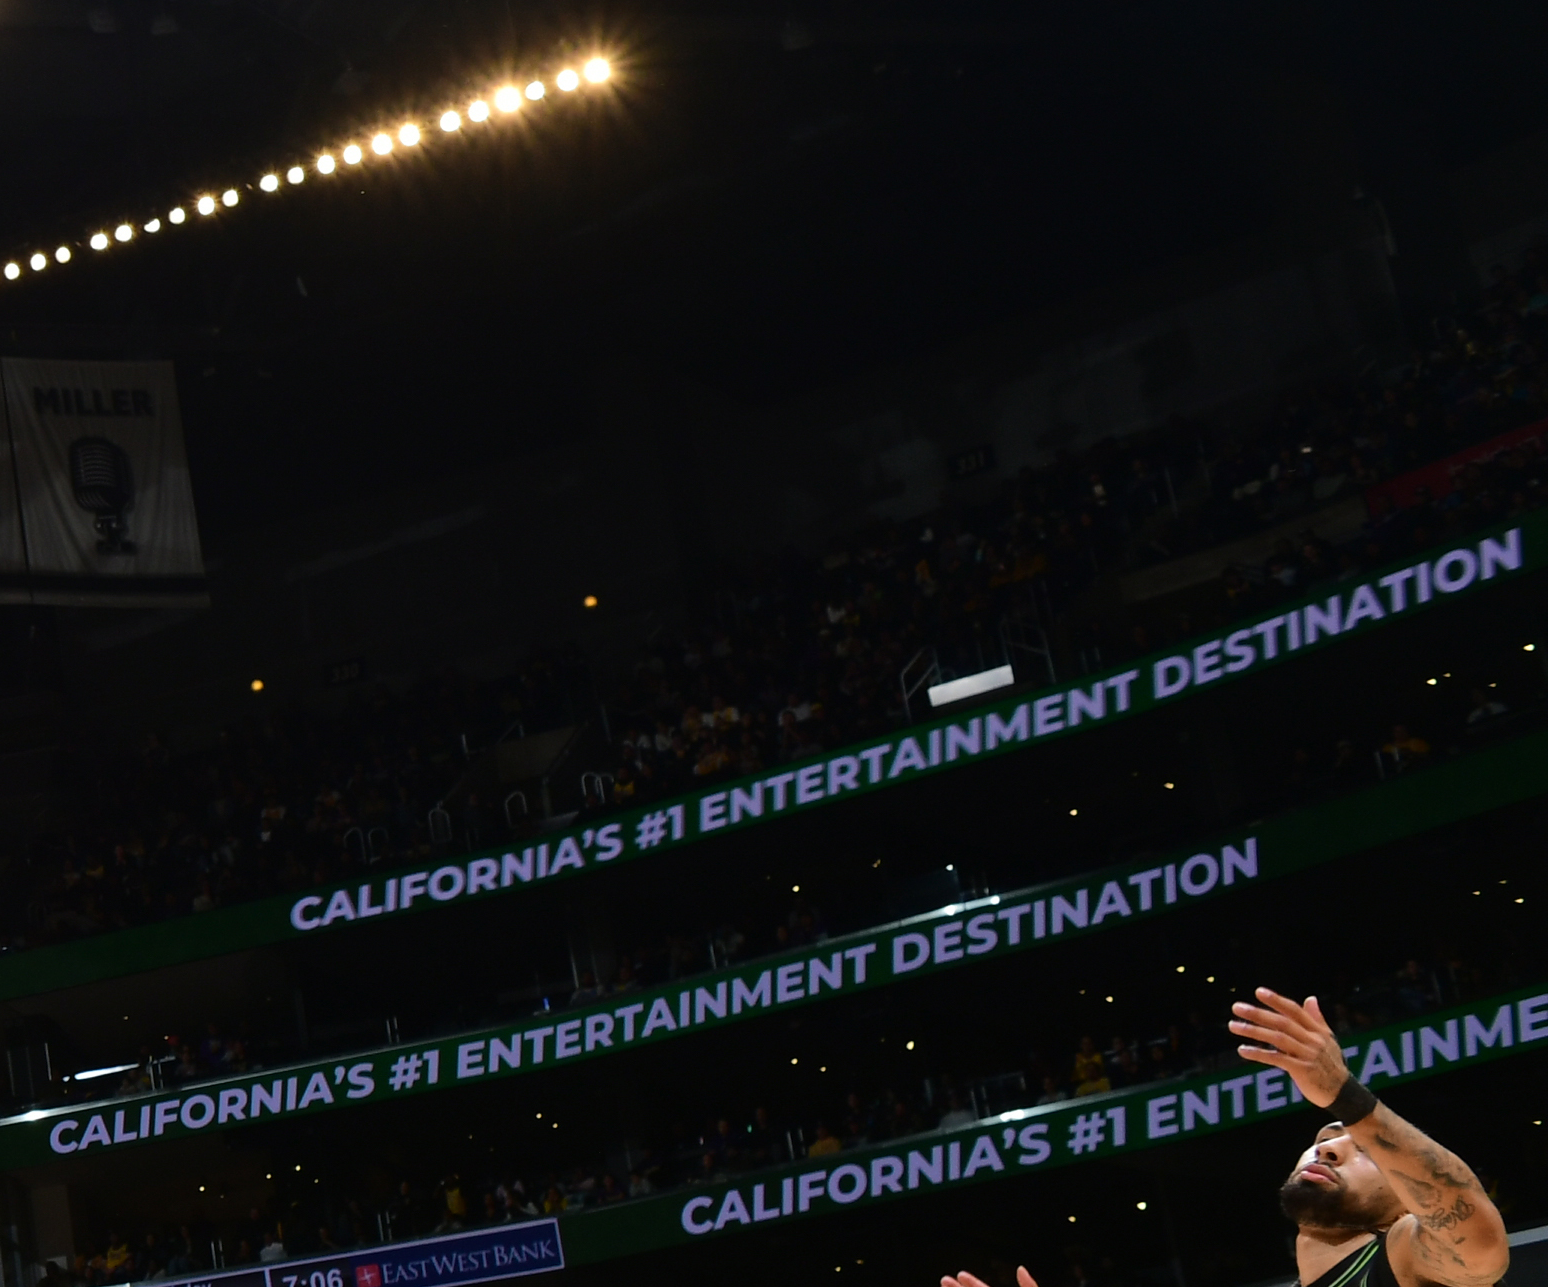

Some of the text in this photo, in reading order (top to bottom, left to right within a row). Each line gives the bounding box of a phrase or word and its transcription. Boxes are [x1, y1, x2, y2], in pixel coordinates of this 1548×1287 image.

[34, 387, 152, 415] MILLER
[292, 529, 1520, 929] CALIFORNIA'S #1 ENTERTAINMENT DESTINATION
[46, 838, 1257, 1153] CALIFORNIA'S #1 ENTERTAINMENT DESTINATION
[682, 1107, 1125, 1234] CALIFORNIA'S #1
